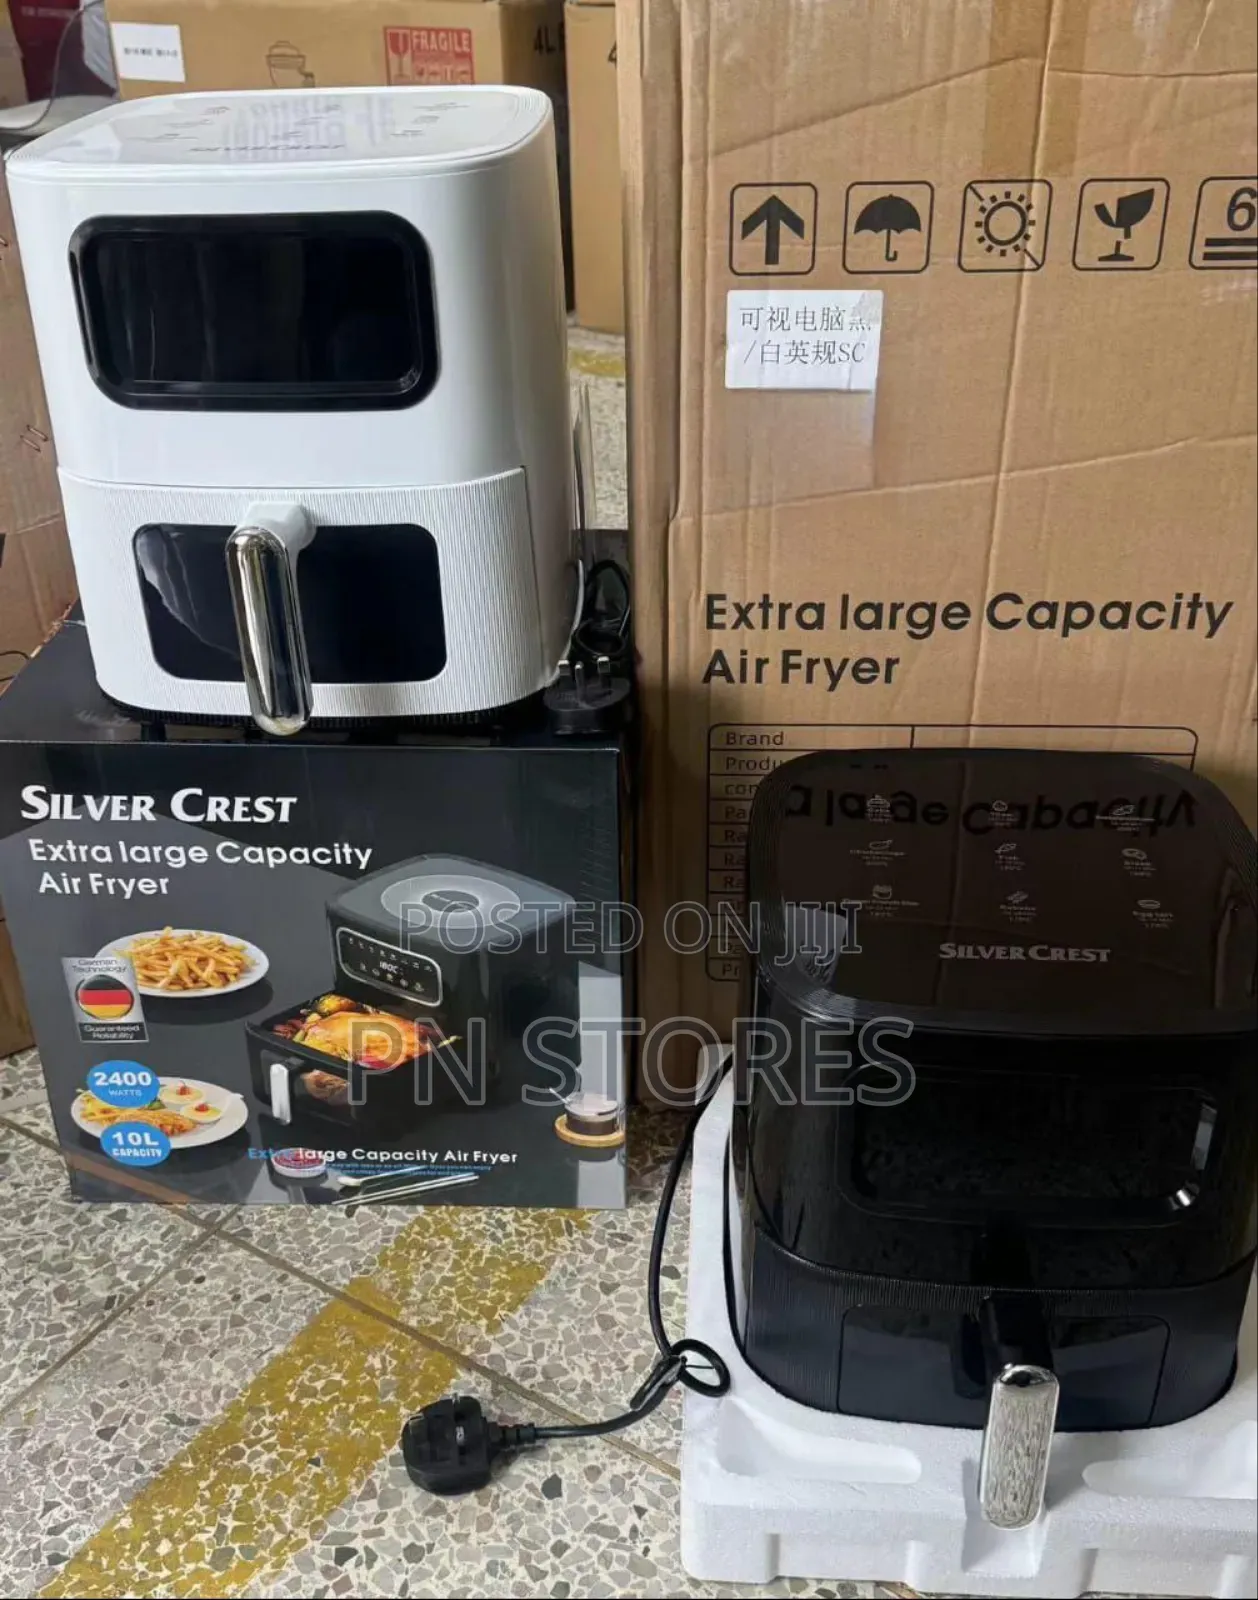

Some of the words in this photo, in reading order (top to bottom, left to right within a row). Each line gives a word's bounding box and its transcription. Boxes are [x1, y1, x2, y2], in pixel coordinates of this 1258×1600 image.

[412, 29, 471, 53] FRAGILE
[705, 593, 826, 632] Extra
[840, 593, 972, 641] large
[985, 591, 1234, 640] Capacity
[702, 648, 770, 685] Air
[780, 648, 900, 693] Fryer
[725, 731, 785, 746] Brand
[20, 784, 157, 822] SILVER
[170, 787, 298, 824] CREST
[28, 838, 113, 863] Extra
[120, 839, 209, 869] large
[216, 841, 373, 870] Capacity
[38, 871, 81, 895] Air
[90, 872, 170, 900] Fryer
[93, 1070, 152, 1087] 2400
[107, 1088, 143, 1098] WATTS
[112, 1131, 160, 1147] 10L
[112, 1147, 163, 1158] CAPACITY
[351, 1148, 439, 1164] Capacity
[443, 1150, 469, 1163] Air
[472, 1150, 518, 1165] Fryer
